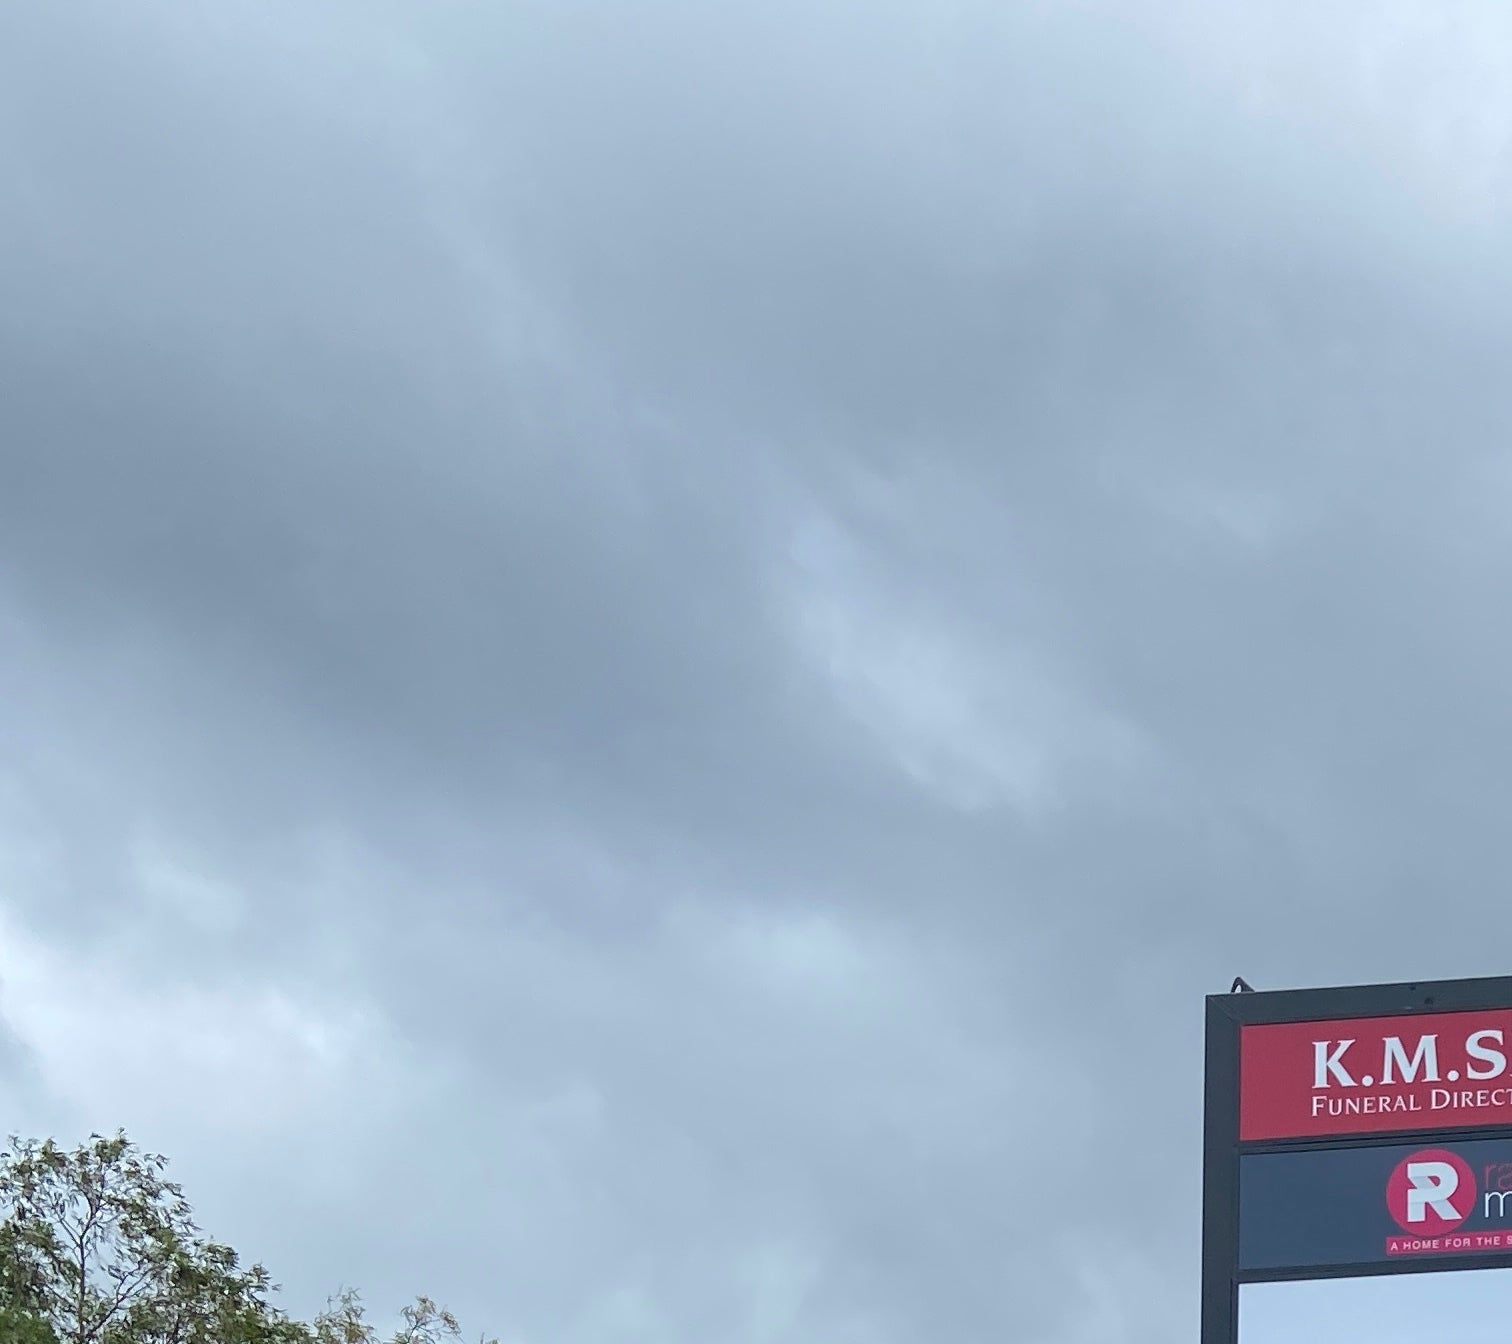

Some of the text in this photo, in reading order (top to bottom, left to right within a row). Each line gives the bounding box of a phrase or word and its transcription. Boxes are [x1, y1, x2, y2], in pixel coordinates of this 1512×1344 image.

[1390, 1241, 1399, 1251] A
[1403, 1239, 1440, 1250] HOME
[1445, 1237, 1471, 1248] FOR
[1477, 1235, 1500, 1247] THE
